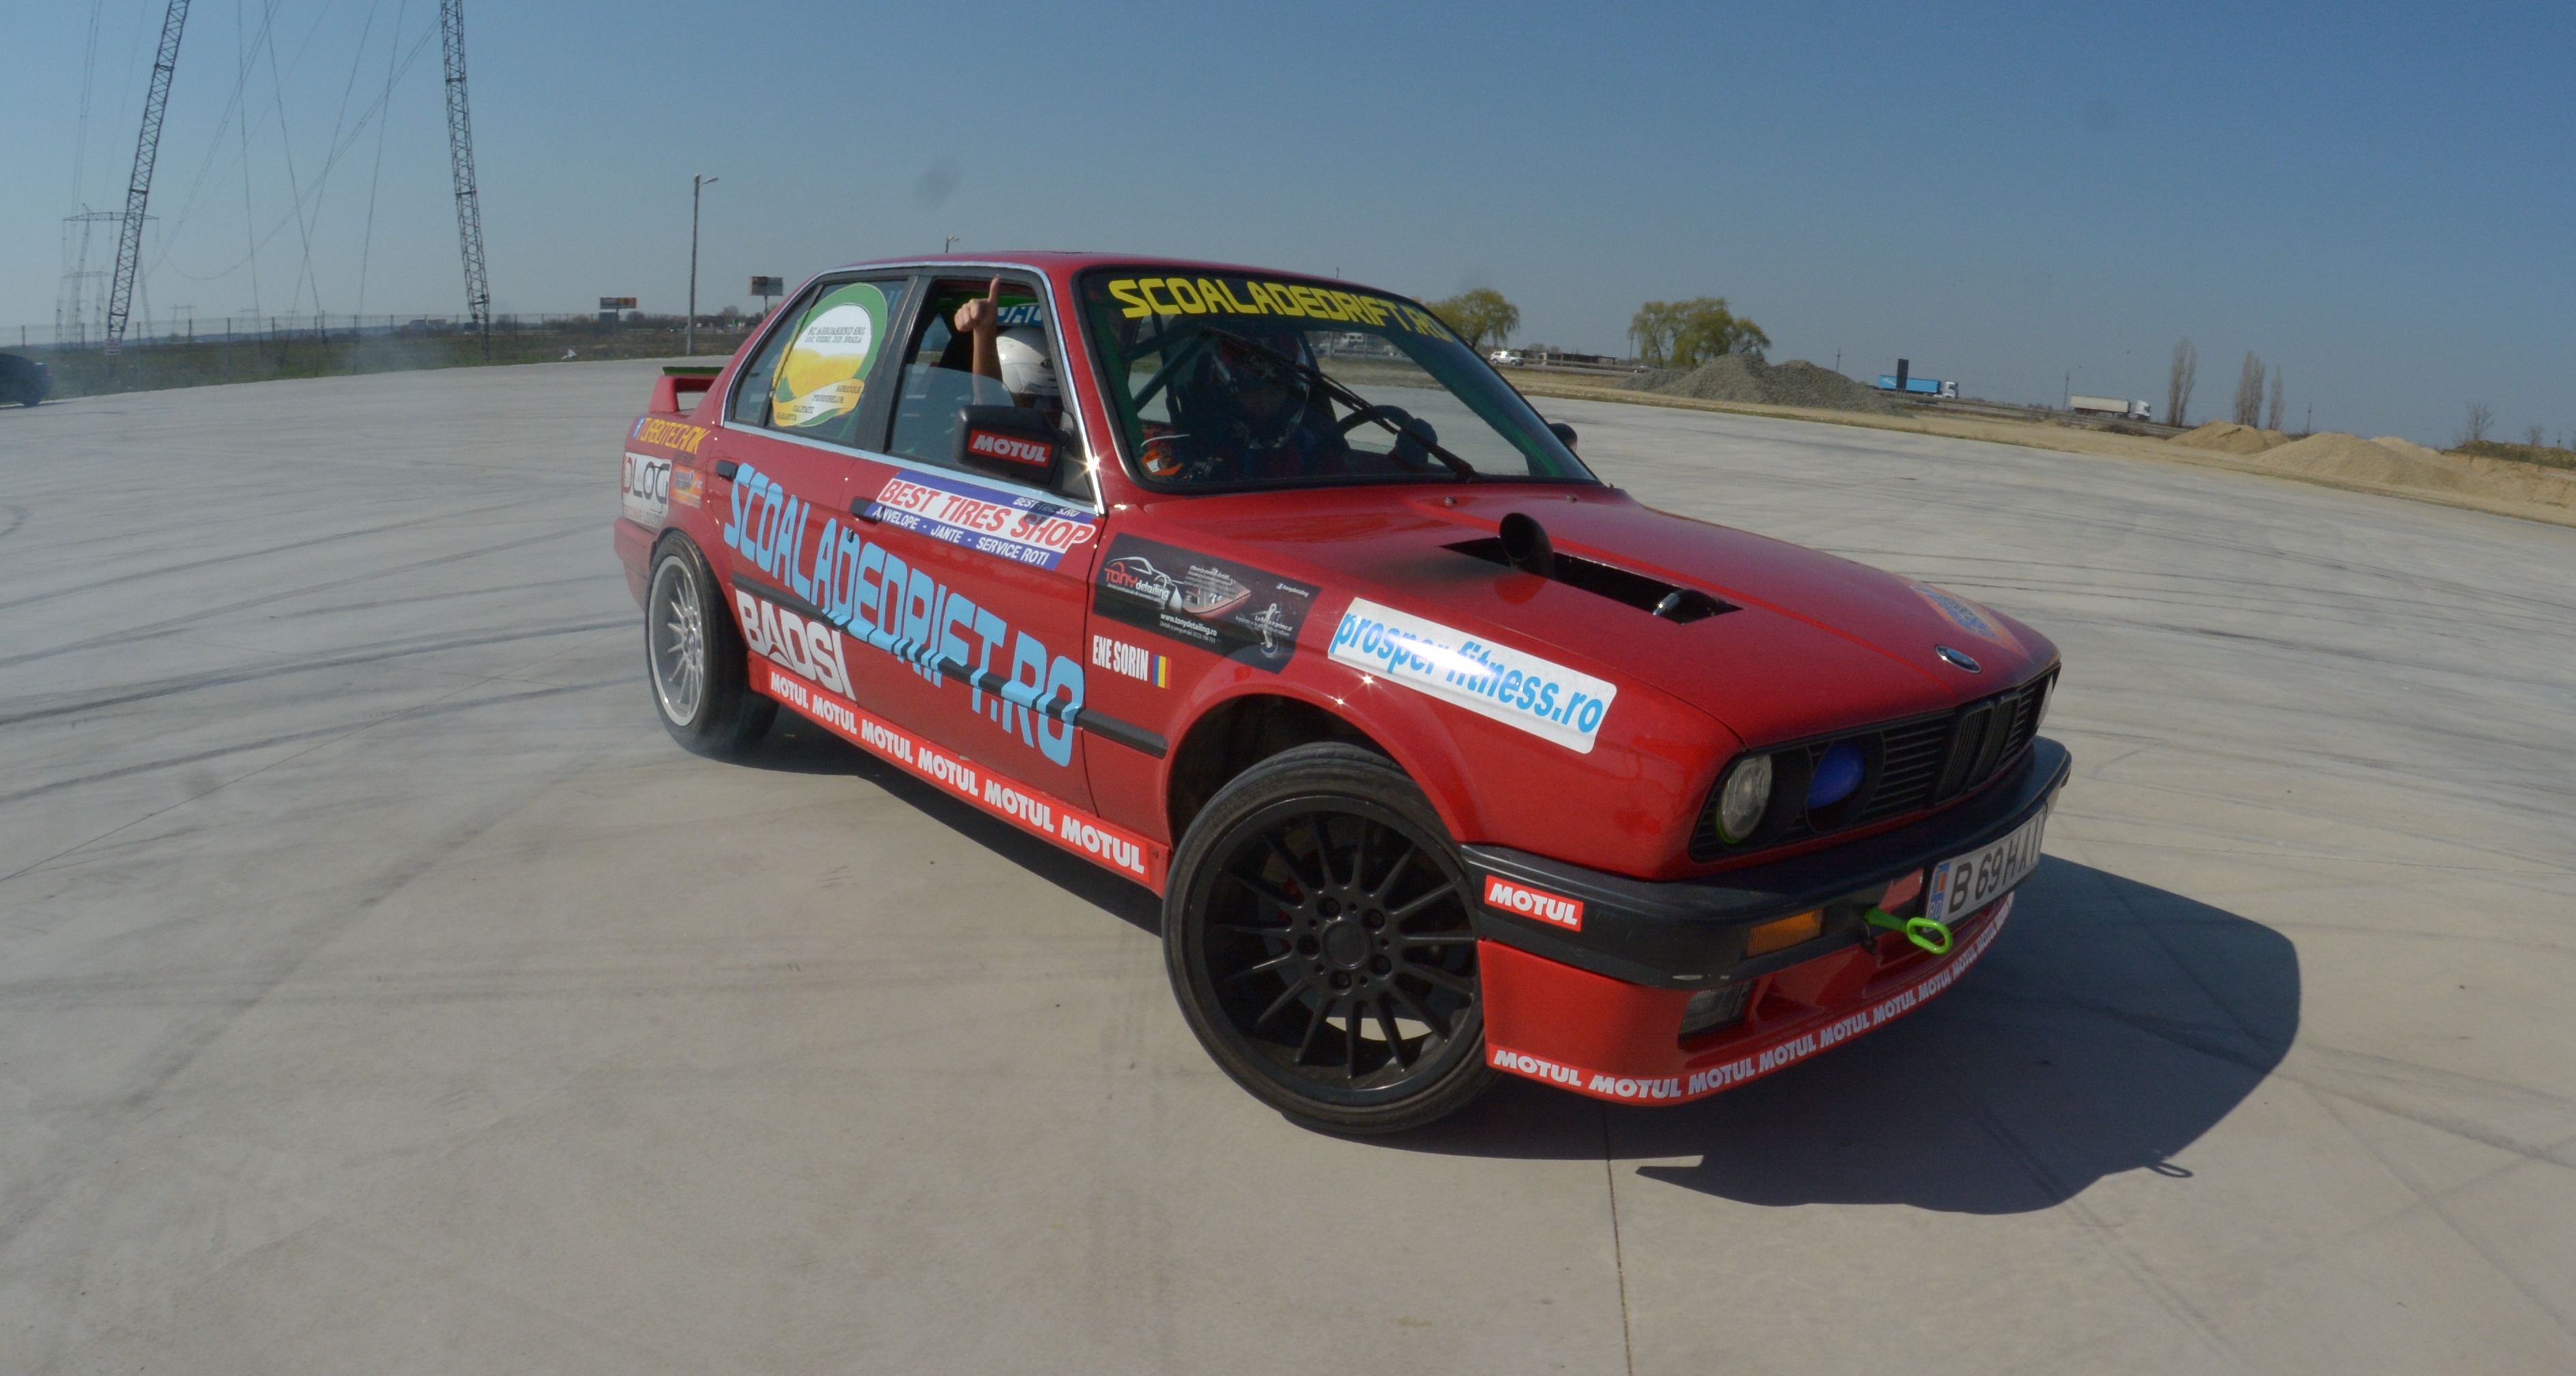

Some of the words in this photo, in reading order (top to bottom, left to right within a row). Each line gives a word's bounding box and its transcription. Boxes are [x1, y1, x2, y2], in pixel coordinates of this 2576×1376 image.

[1108, 278, 1453, 342] SCOALADEDRIFT.RO
[971, 435, 1046, 464] MOTUL
[878, 480, 941, 512] BEST
[939, 495, 1012, 533] TIRES
[1010, 514, 1093, 550] SHOP
[930, 523, 964, 544] JANTE
[975, 536, 1020, 560] SERVICE
[1020, 547, 1050, 566] ROTI
[724, 462, 1085, 767] SCOALADEDRIFT.RO
[1093, 635, 1112, 670] ENE
[1113, 639, 1149, 682] SORIN
[771, 671, 809, 709] MOTUL
[812, 693, 857, 735] MOTUL
[861, 719, 913, 764] MOTUL
[917, 747, 979, 797] MOTUL
[984, 779, 1055, 833] MOTUL
[1061, 814, 1145, 874] MOTUL
[1488, 882, 1578, 926] MOTUL
[1948, 861, 1973, 914] B
[1975, 846, 2004, 901] 69
[1493, 1049, 1582, 1087] MOTUL
[1588, 1074, 1682, 1100] MOTUL
[1687, 1057, 1756, 1095] MOTUL
[1758, 1035, 1816, 1074] MOTUL
[1820, 1012, 1870, 1049] MOTUL
[1872, 989, 1917, 1025] MOTUL
[1918, 972, 1953, 1002] MOTUL
[1952, 952, 1978, 981] MOTUL
